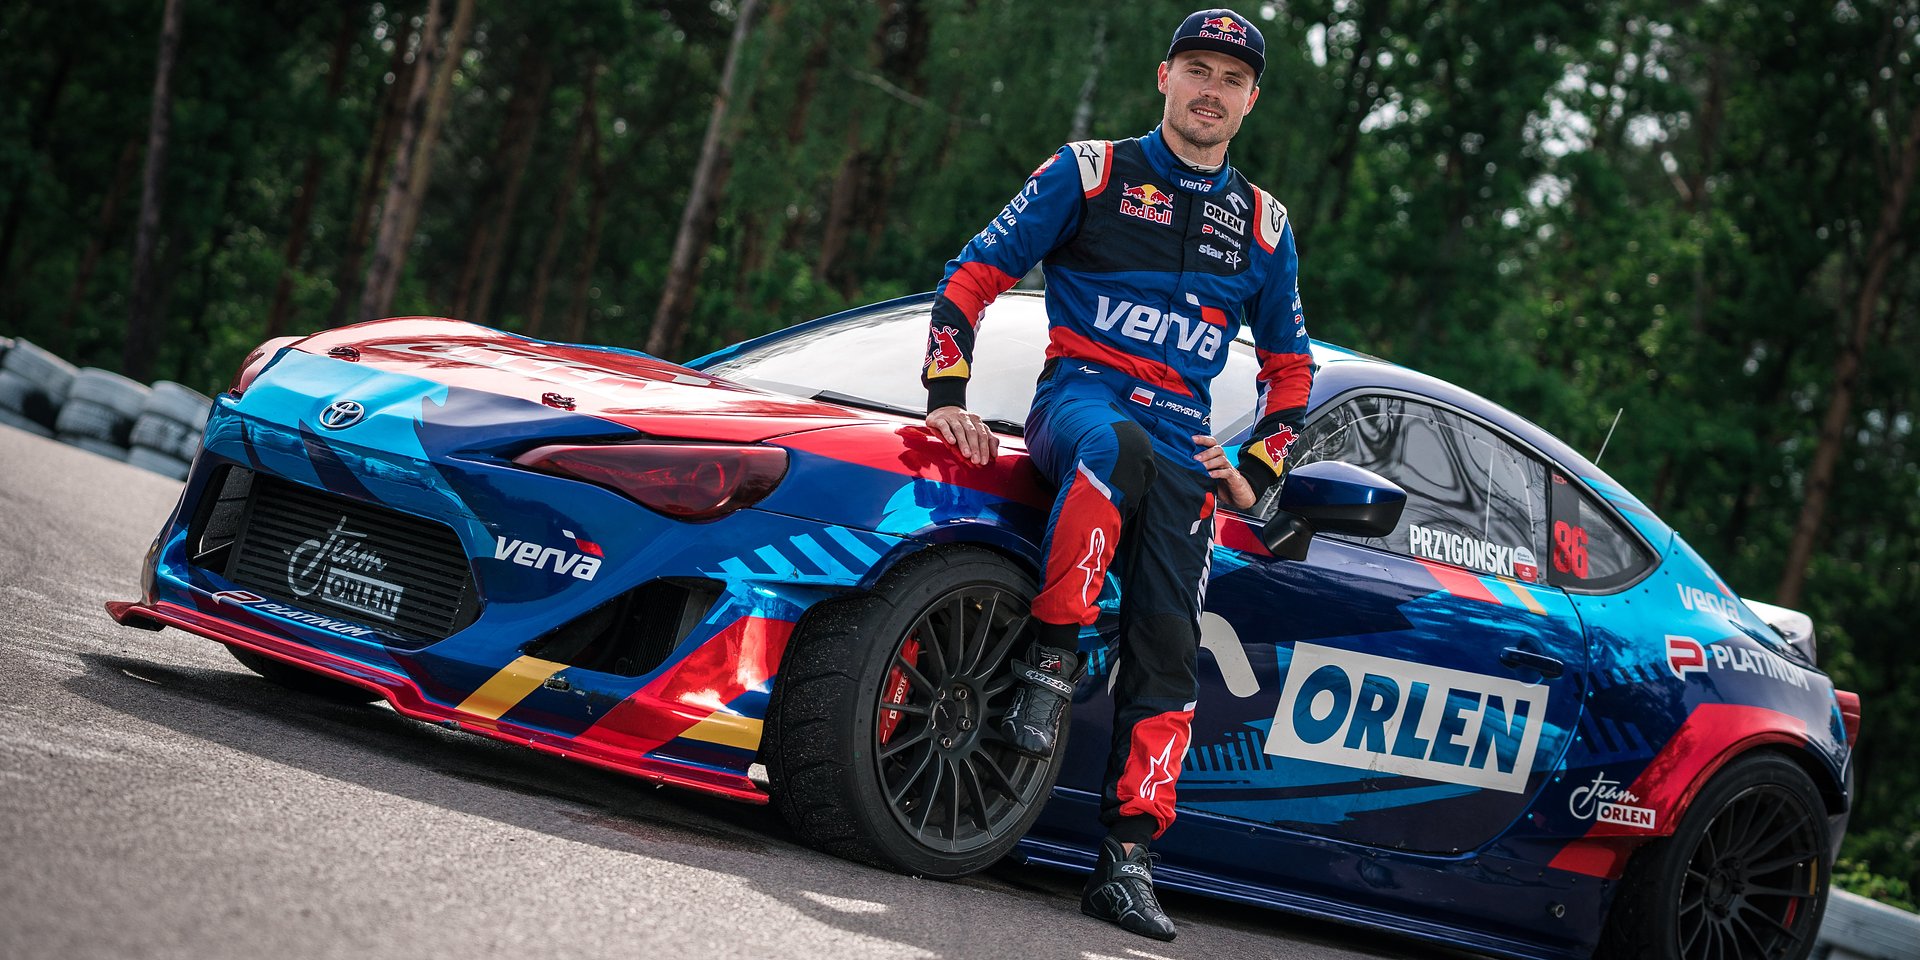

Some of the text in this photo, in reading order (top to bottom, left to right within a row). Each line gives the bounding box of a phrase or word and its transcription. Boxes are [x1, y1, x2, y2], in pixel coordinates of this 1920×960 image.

[1224, 33, 1246, 46] Bll
[1180, 179, 1212, 192] verva
[1120, 199, 1172, 225] Red Bull
[1206, 205, 1242, 231] ORLEN
[1198, 244, 1223, 259] star
[1093, 295, 1222, 360] verva
[494, 535, 602, 581] verva
[1409, 524, 1514, 577] PRZYGONSKI
[1553, 520, 1588, 579] 86
[329, 578, 399, 616] ORLEN
[256, 603, 374, 637] PLATINUM
[1710, 644, 1811, 691] PLATINUM
[1292, 664, 1531, 775] ORLEN
[1601, 805, 1652, 826] ORLEN
